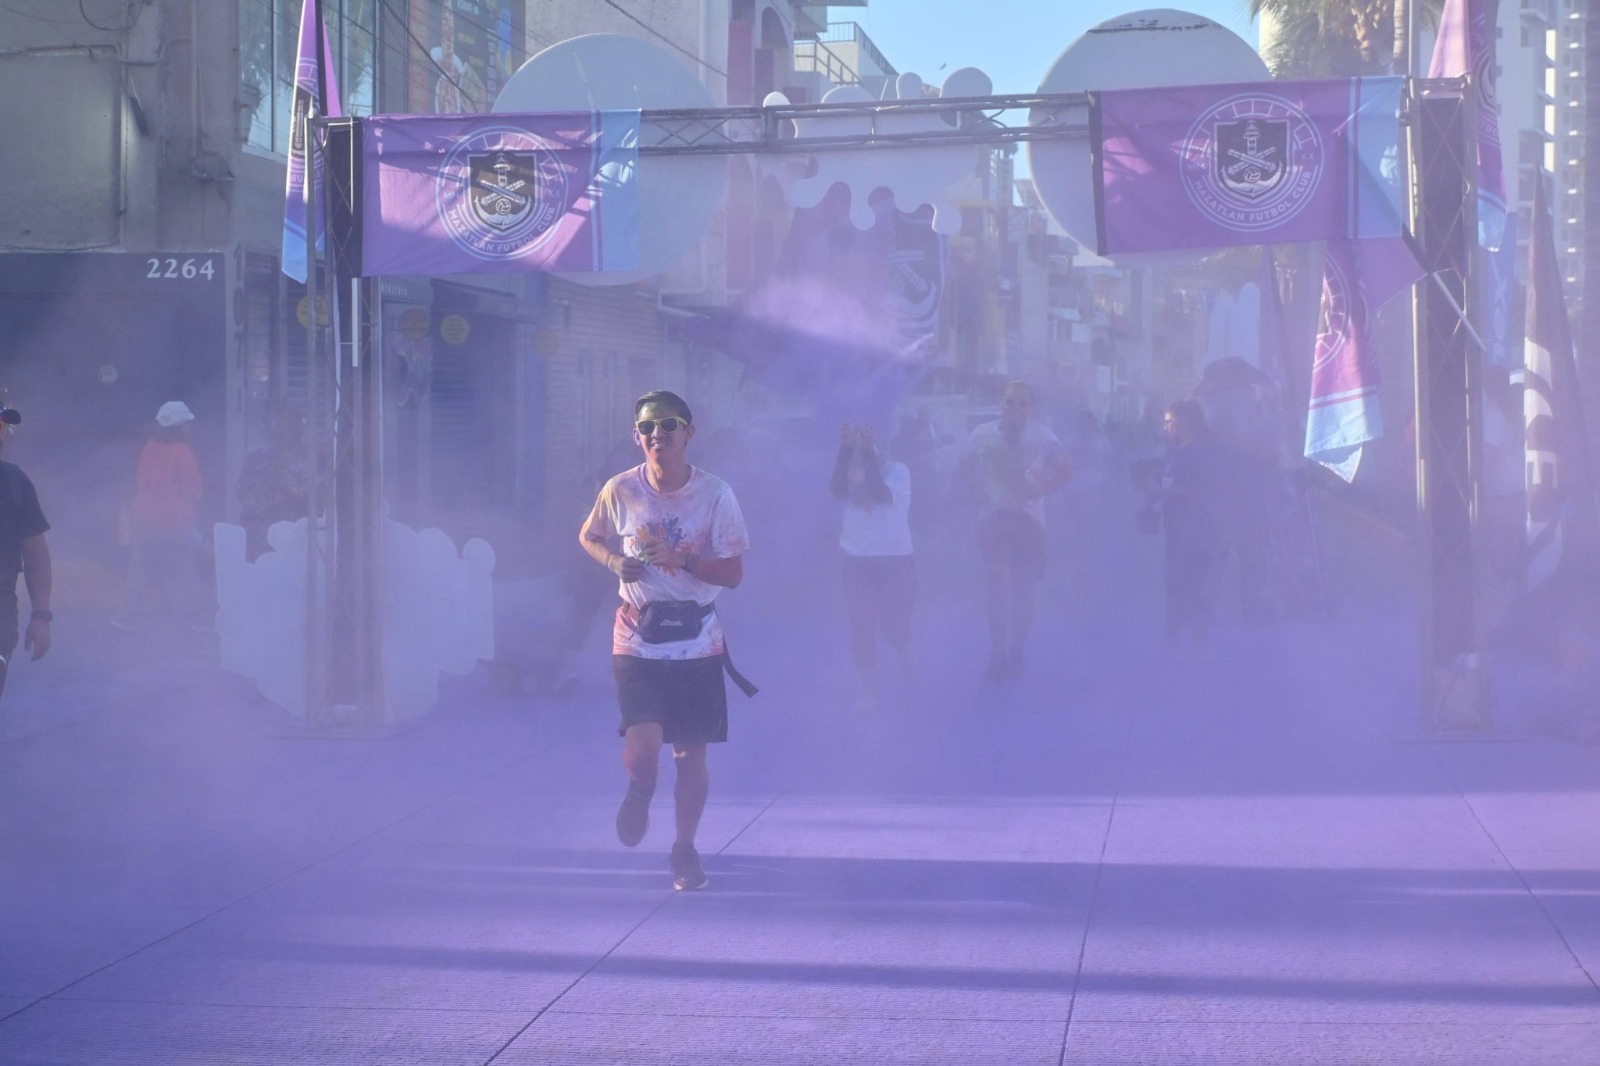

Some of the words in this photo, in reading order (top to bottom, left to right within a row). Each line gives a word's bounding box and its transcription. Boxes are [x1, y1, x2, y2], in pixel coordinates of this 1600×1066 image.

[1250, 201, 1292, 221] FUTBOL
[1292, 171, 1311, 198] CLUB
[537, 207, 555, 232] CLUB
[146, 258, 215, 280] 2264
